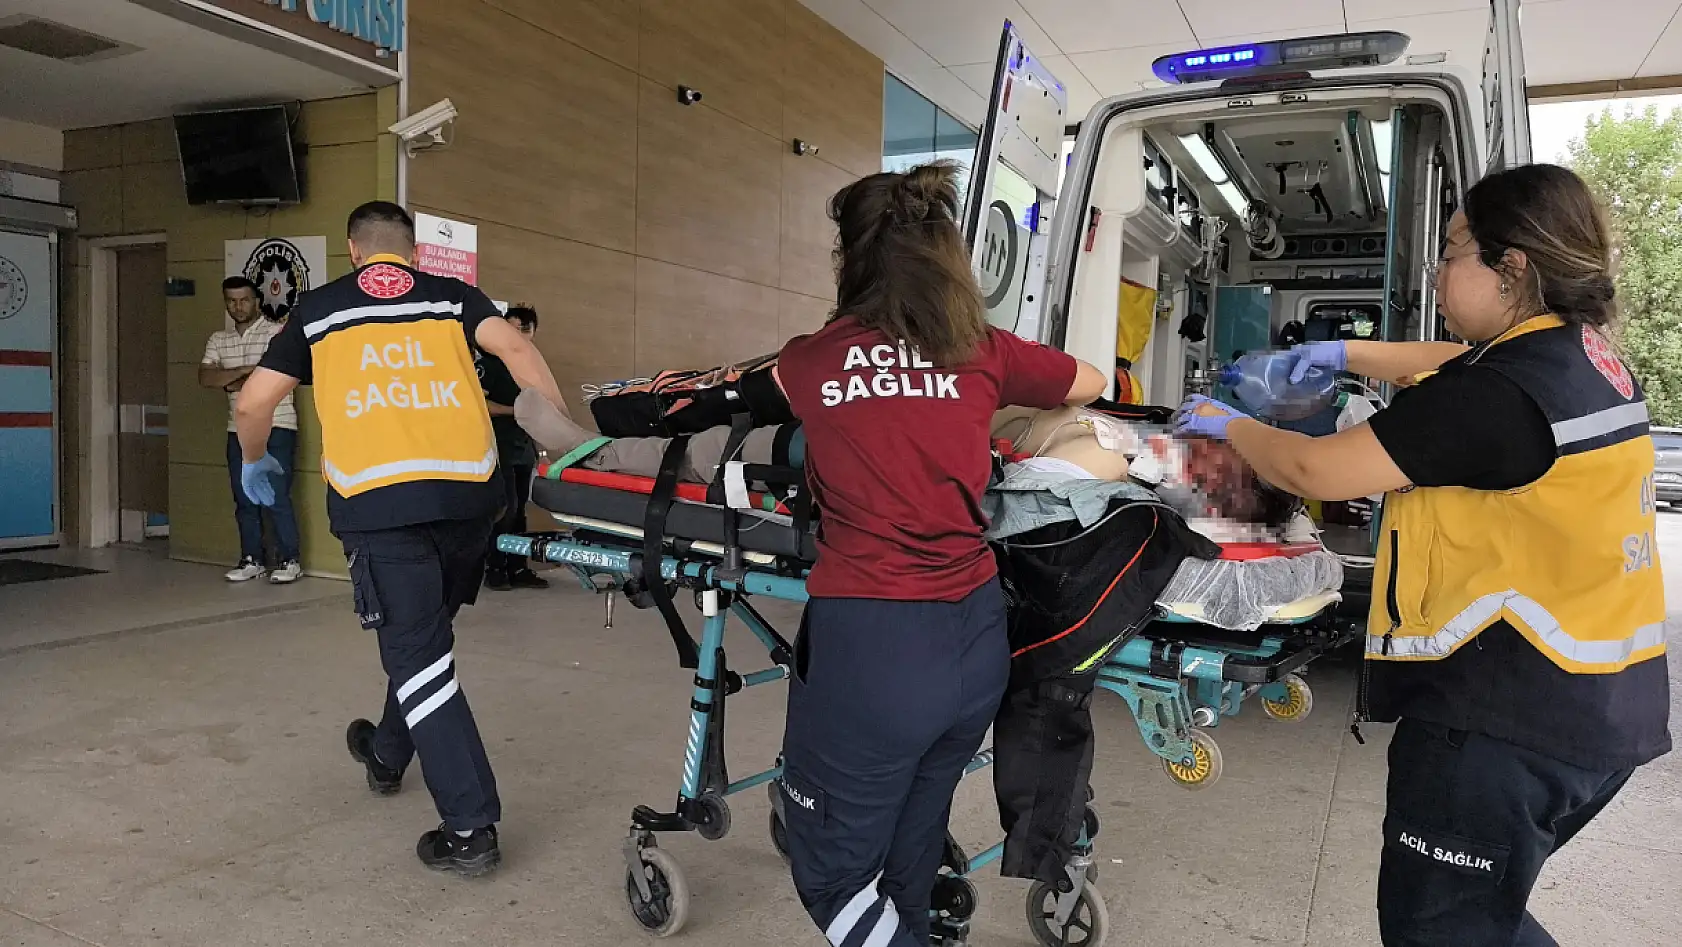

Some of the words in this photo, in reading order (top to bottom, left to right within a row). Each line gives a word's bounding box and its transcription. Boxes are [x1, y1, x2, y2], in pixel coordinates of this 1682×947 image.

[424, 245, 436, 256] BU
[437, 247, 468, 262] ALANDA
[360, 335, 435, 371] ACİL
[345, 376, 461, 418] SAĞLIK
[821, 366, 960, 407] SAĞLIK
[1399, 831, 1429, 856] ACİL
[1433, 847, 1494, 872] SAĞLIK
